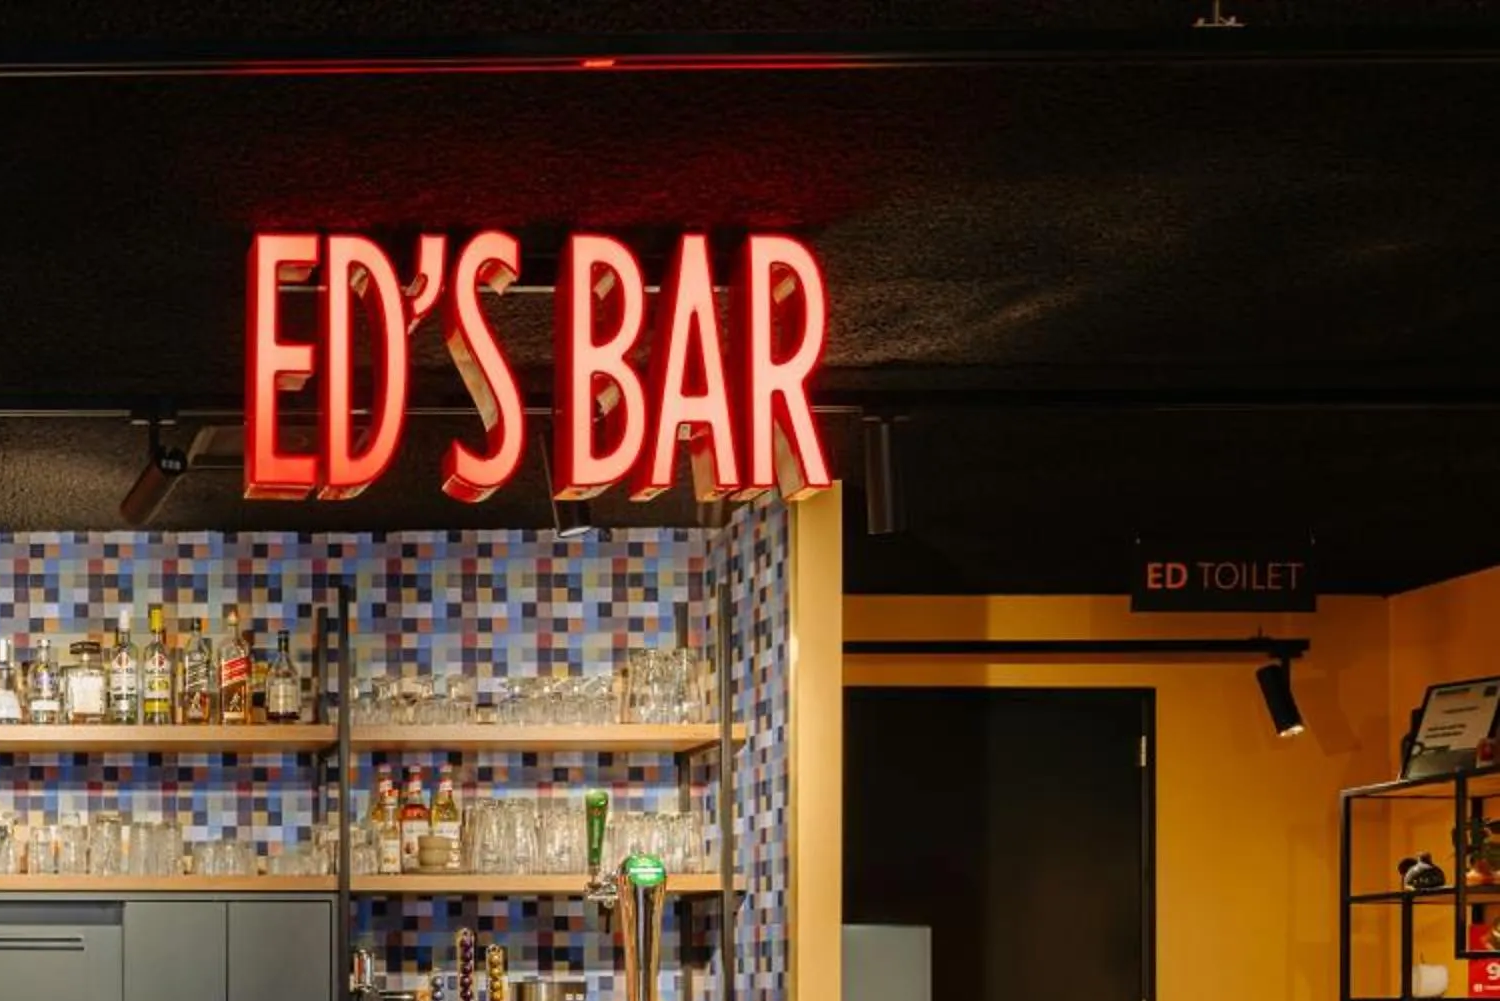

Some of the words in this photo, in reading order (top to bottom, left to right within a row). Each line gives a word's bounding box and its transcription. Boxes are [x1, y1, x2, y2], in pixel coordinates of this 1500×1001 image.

[248, 230, 524, 496] ED'S
[560, 233, 833, 496] BAR
[1147, 562, 1189, 589] ED
[1197, 562, 1304, 590] TOILET
